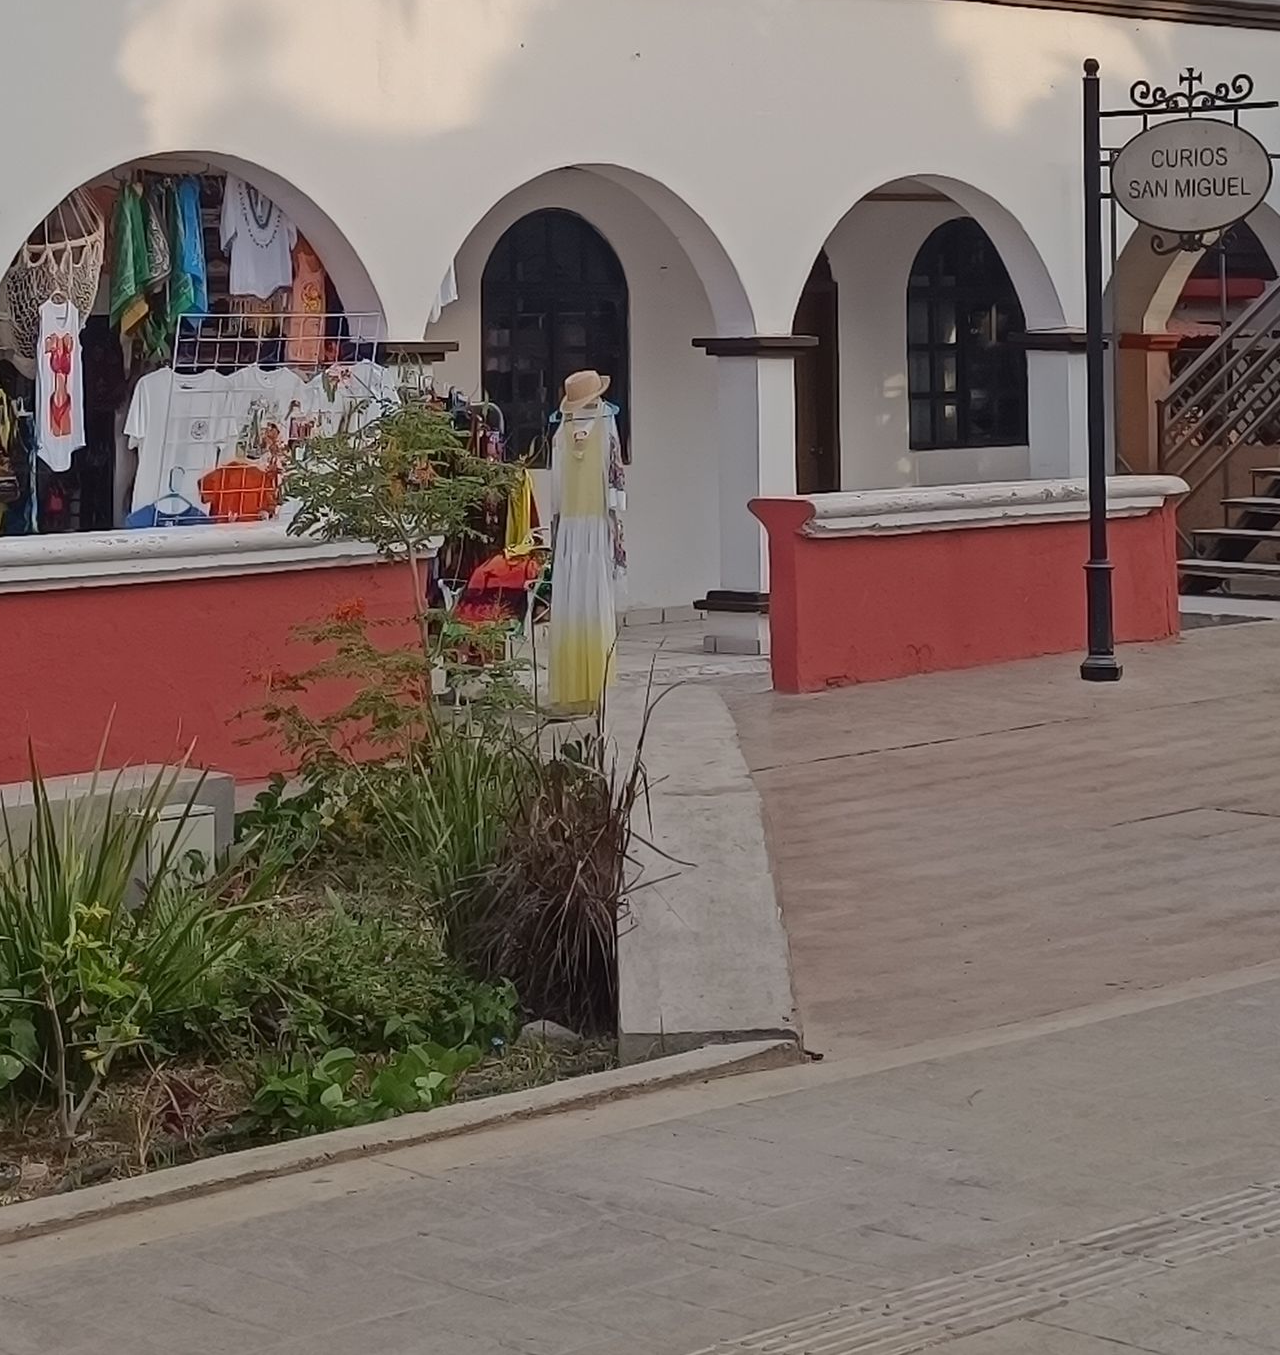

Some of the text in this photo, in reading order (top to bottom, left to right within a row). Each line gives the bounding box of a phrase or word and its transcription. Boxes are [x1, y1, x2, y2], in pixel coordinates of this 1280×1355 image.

[1151, 147, 1228, 168] CURIOS
[1128, 177, 1251, 199] SAN MIGUEL
